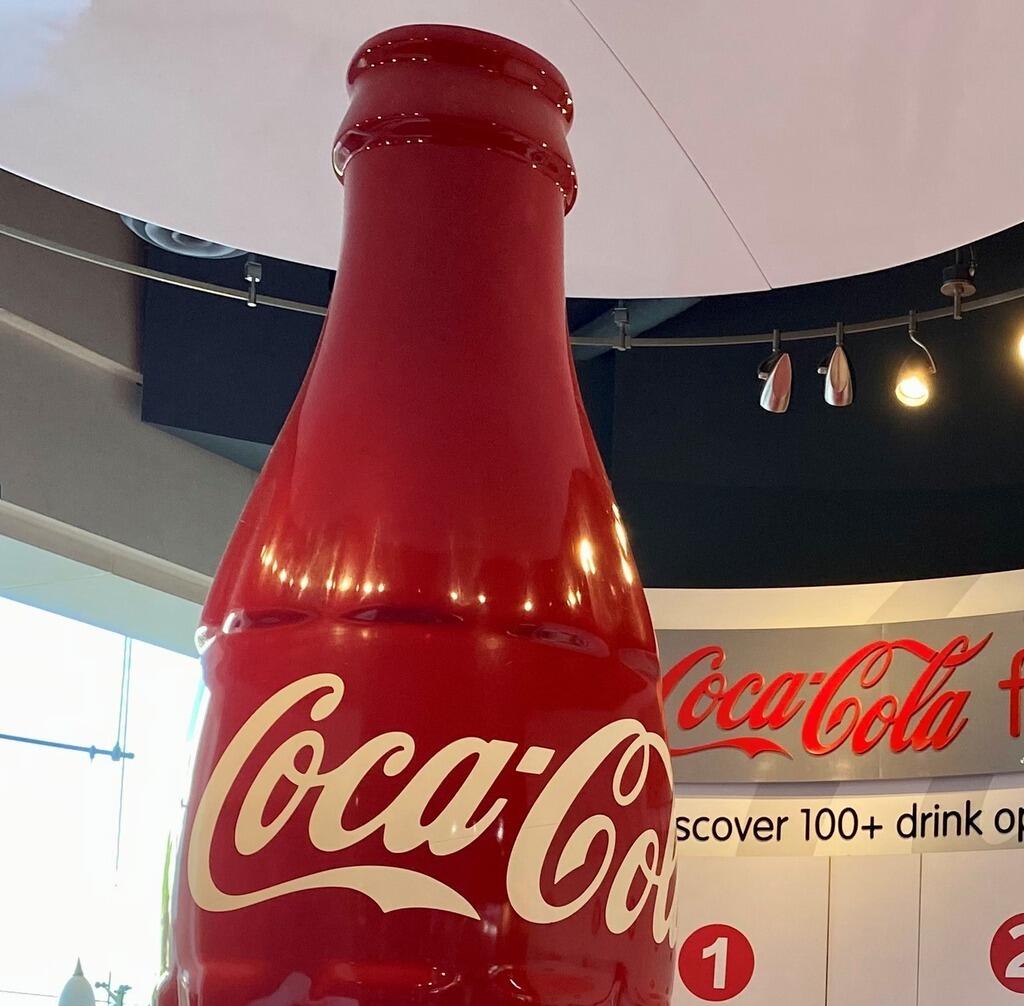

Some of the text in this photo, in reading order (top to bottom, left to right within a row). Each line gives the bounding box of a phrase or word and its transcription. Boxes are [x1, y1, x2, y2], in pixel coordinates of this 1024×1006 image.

[676, 814, 789, 842] scover
[800, 806, 884, 842] 100+
[896, 799, 983, 840] drink
[701, 936, 729, 990] 1
